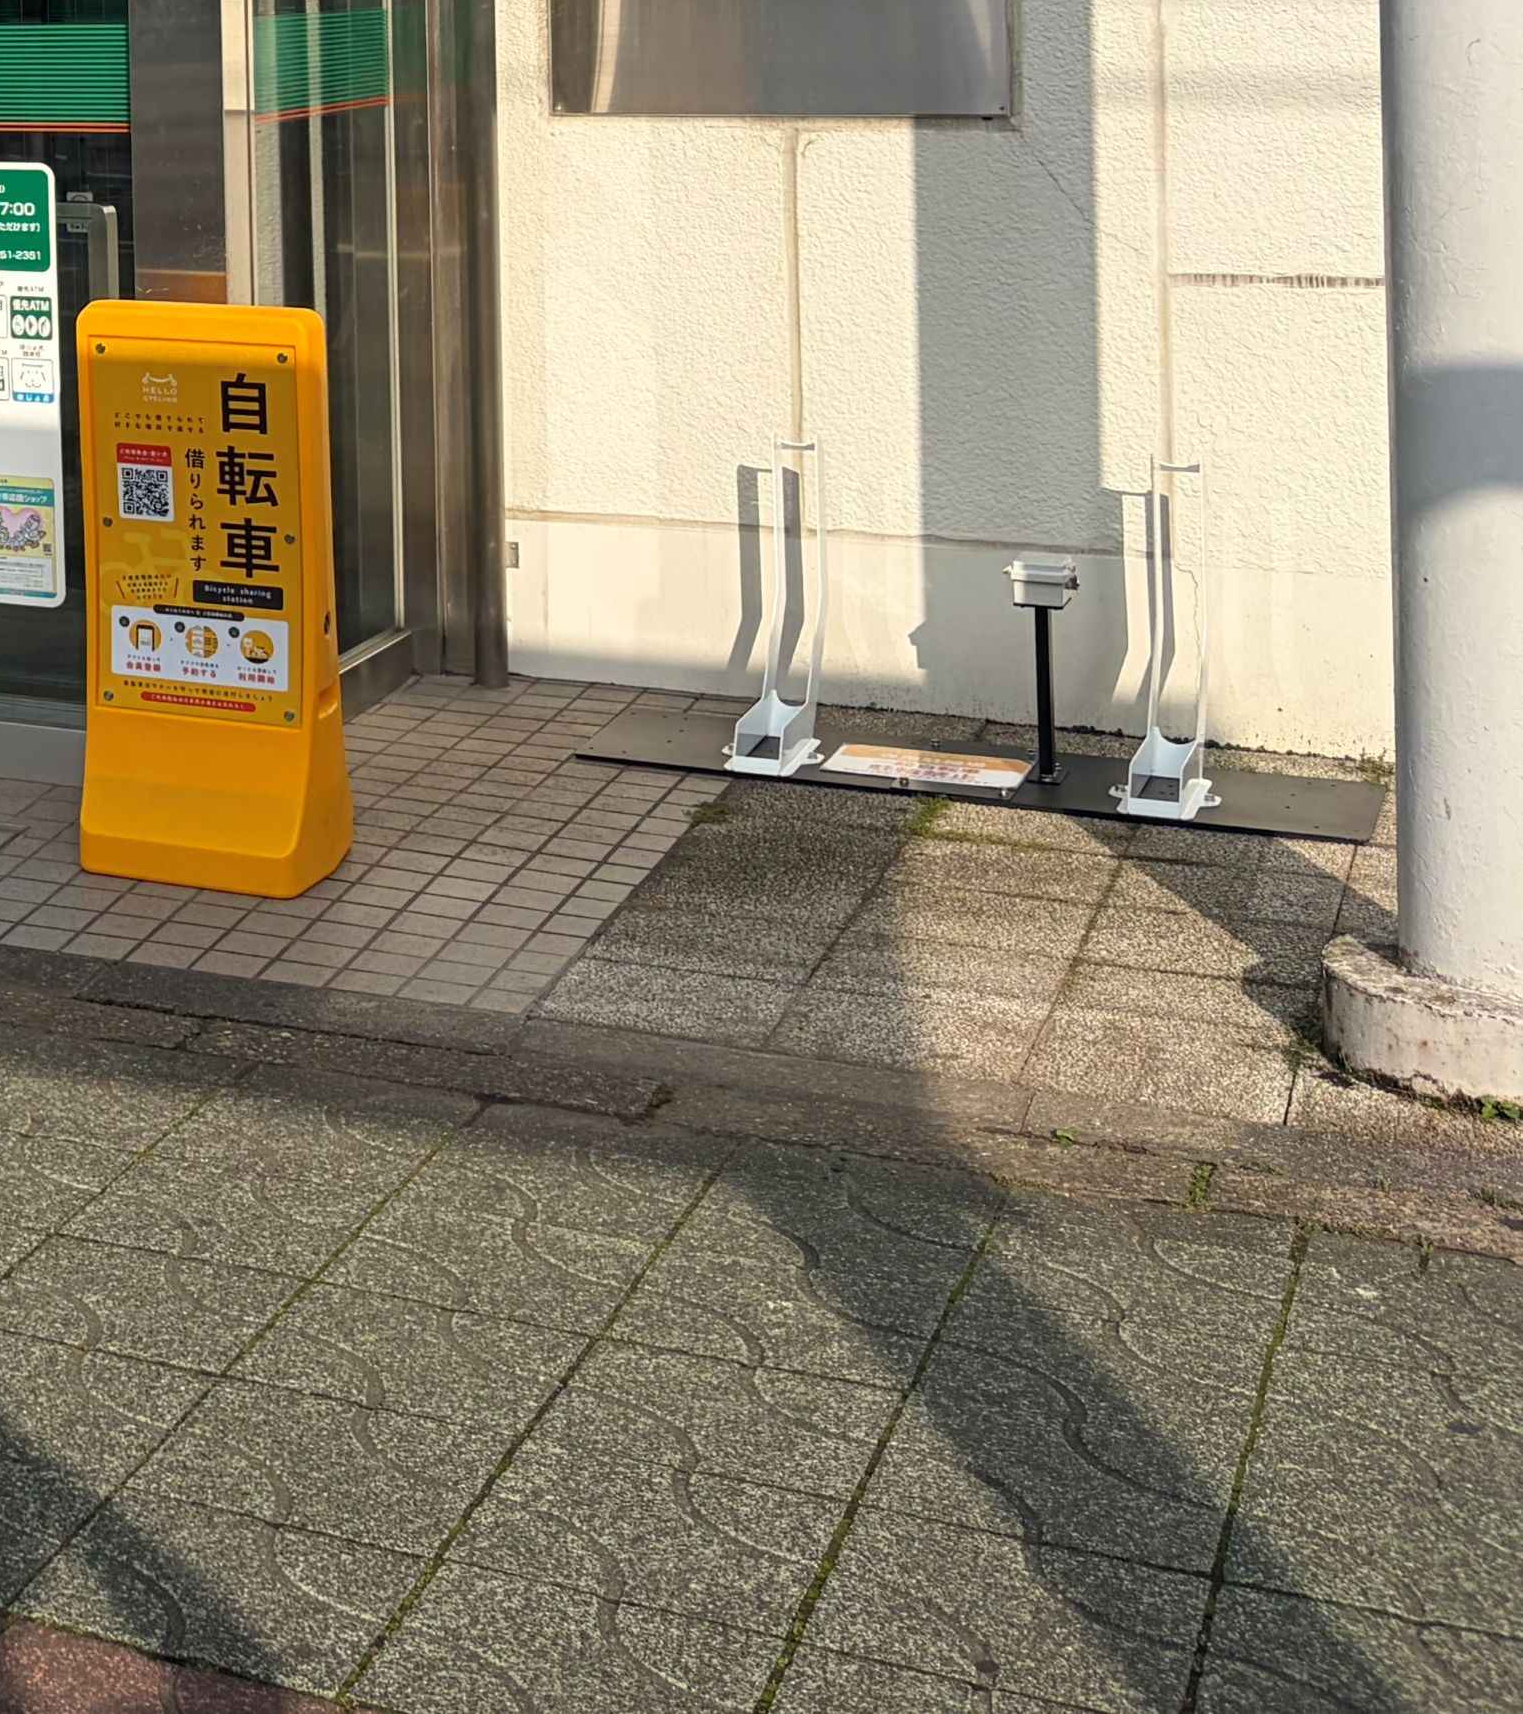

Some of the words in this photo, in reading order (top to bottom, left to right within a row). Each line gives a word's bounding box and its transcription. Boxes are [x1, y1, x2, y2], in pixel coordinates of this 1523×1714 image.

[142, 386, 178, 396] HELLO
[216, 372, 281, 578] 自転車
[185, 448, 207, 572] 借りられます
[204, 584, 235, 595] Bicycle
[240, 587, 272, 599] sharing
[222, 595, 253, 604] station
[183, 667, 216, 678] 予約する
